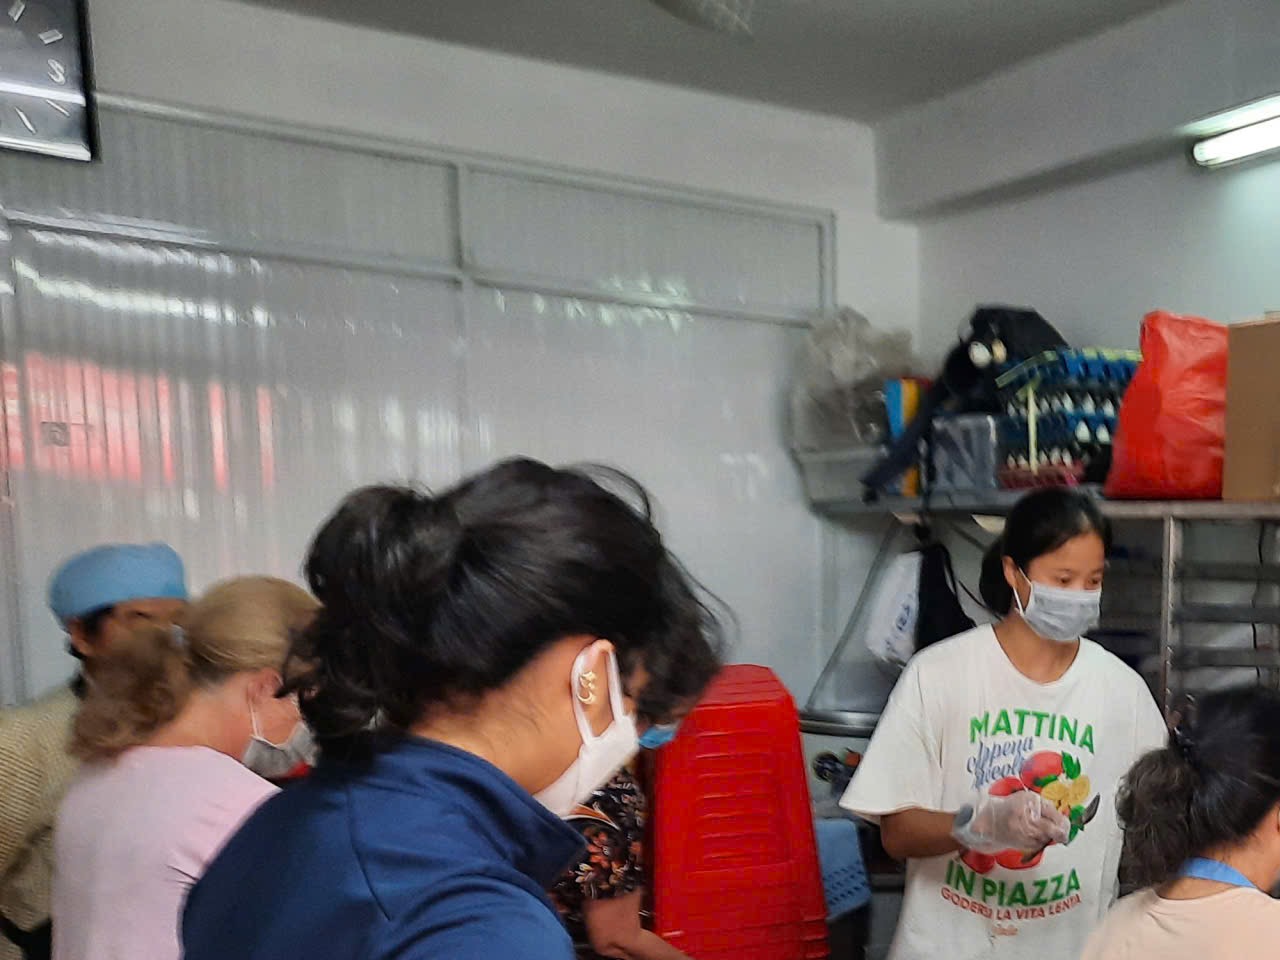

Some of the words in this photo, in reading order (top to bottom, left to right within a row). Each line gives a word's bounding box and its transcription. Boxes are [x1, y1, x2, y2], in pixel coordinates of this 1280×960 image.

[969, 708, 1095, 755] MATTINA
[946, 860, 976, 896] IN
[981, 867, 1080, 906] PIAZZA
[996, 908, 1012, 920] LA
[1016, 908, 1046, 920] VITA
